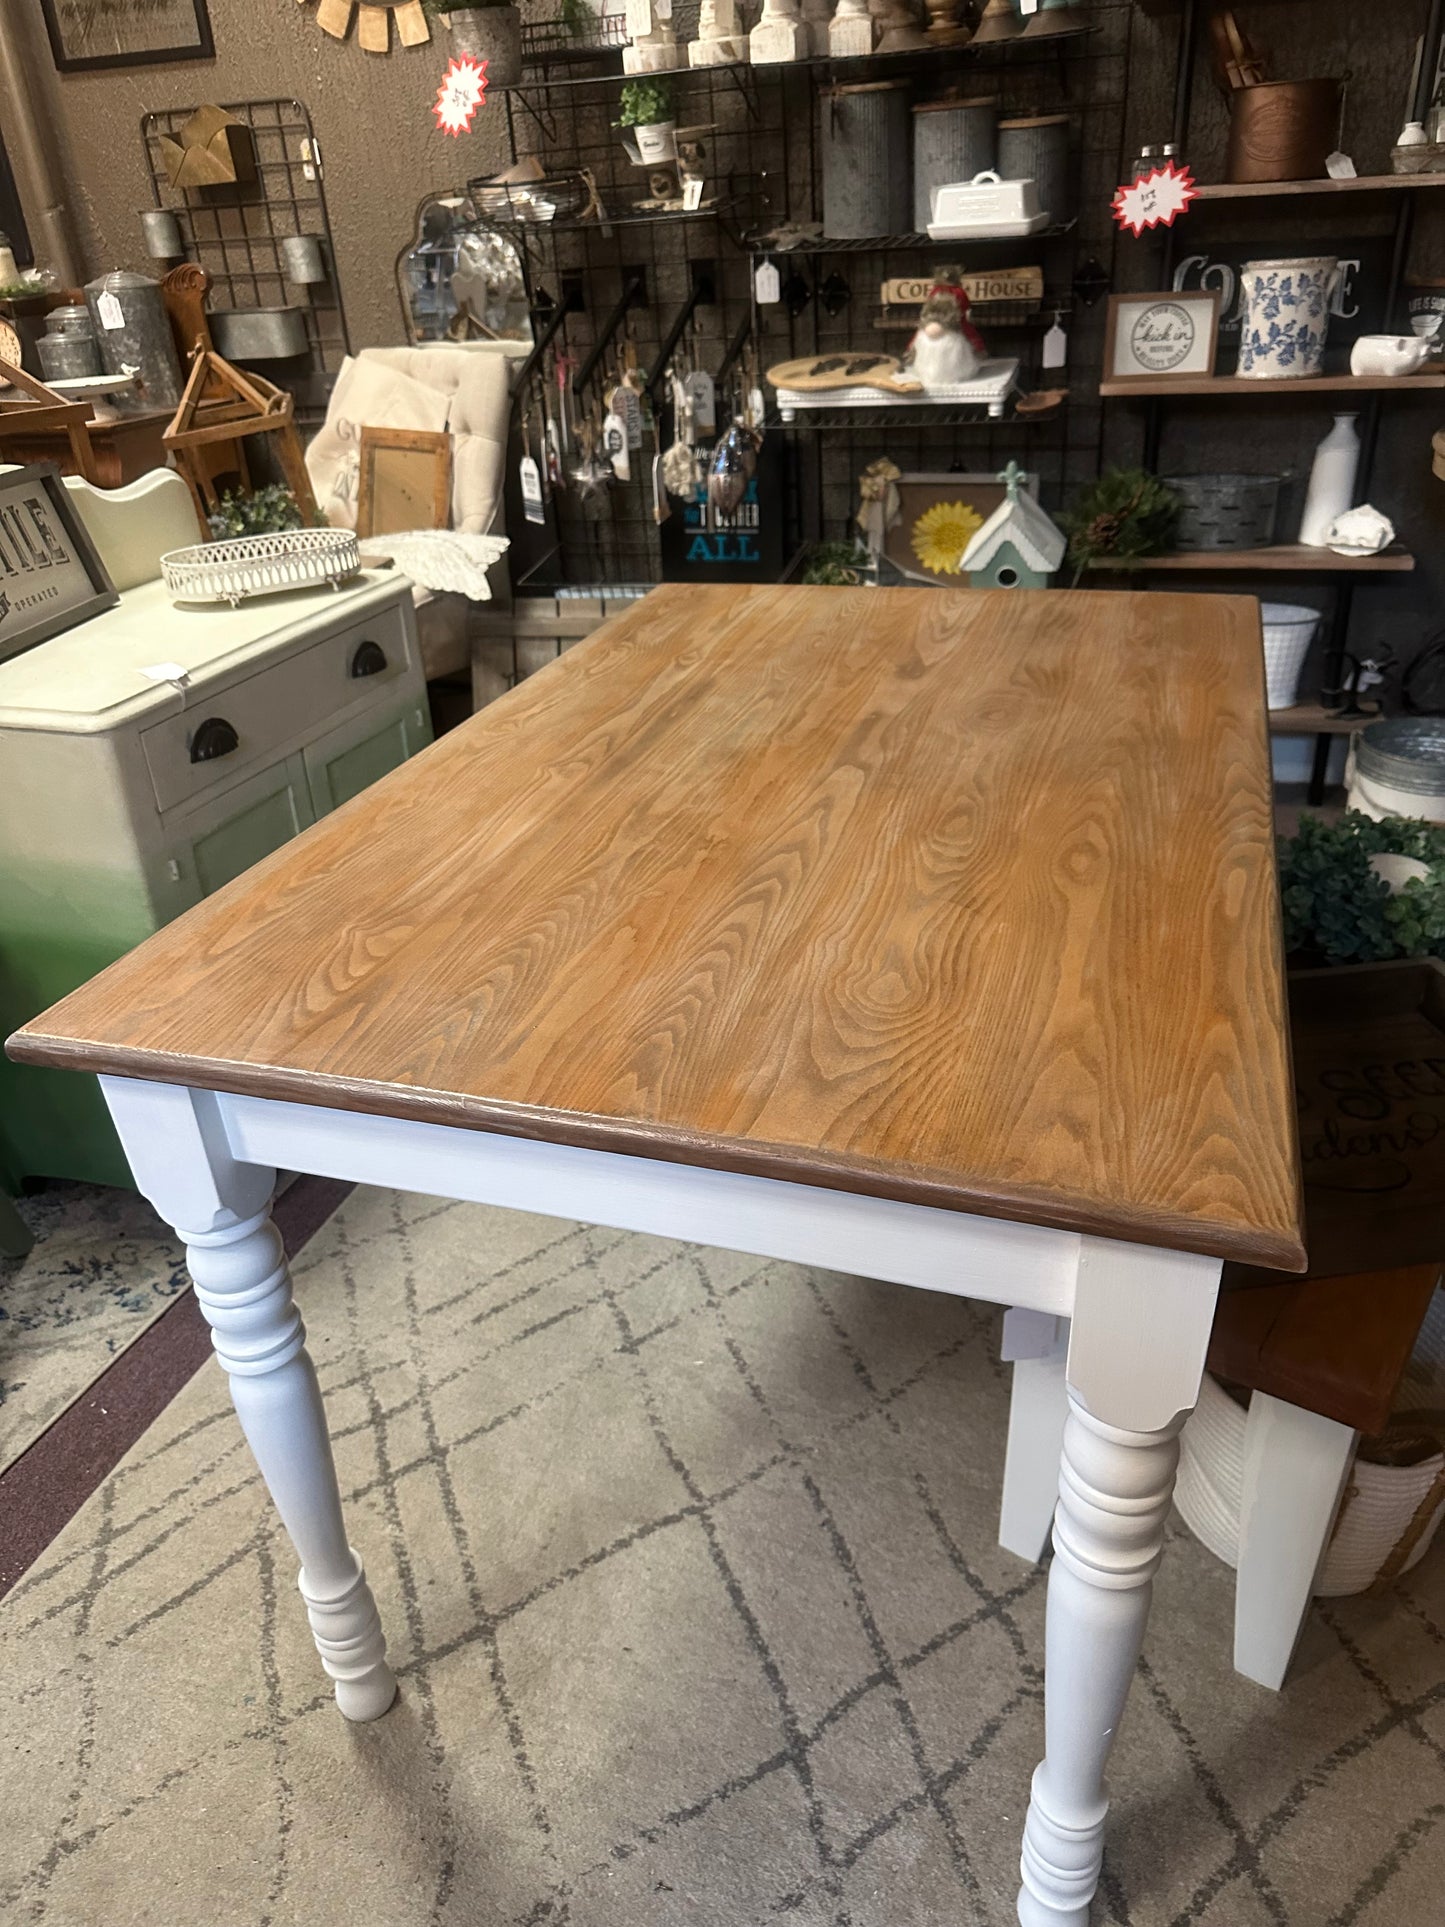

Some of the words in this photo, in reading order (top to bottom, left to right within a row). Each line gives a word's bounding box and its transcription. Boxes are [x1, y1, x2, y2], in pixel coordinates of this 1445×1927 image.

[975, 281, 1033, 298] HOUSE
[686, 533, 761, 562] ALL
[14, 585, 59, 612] OPERATED
